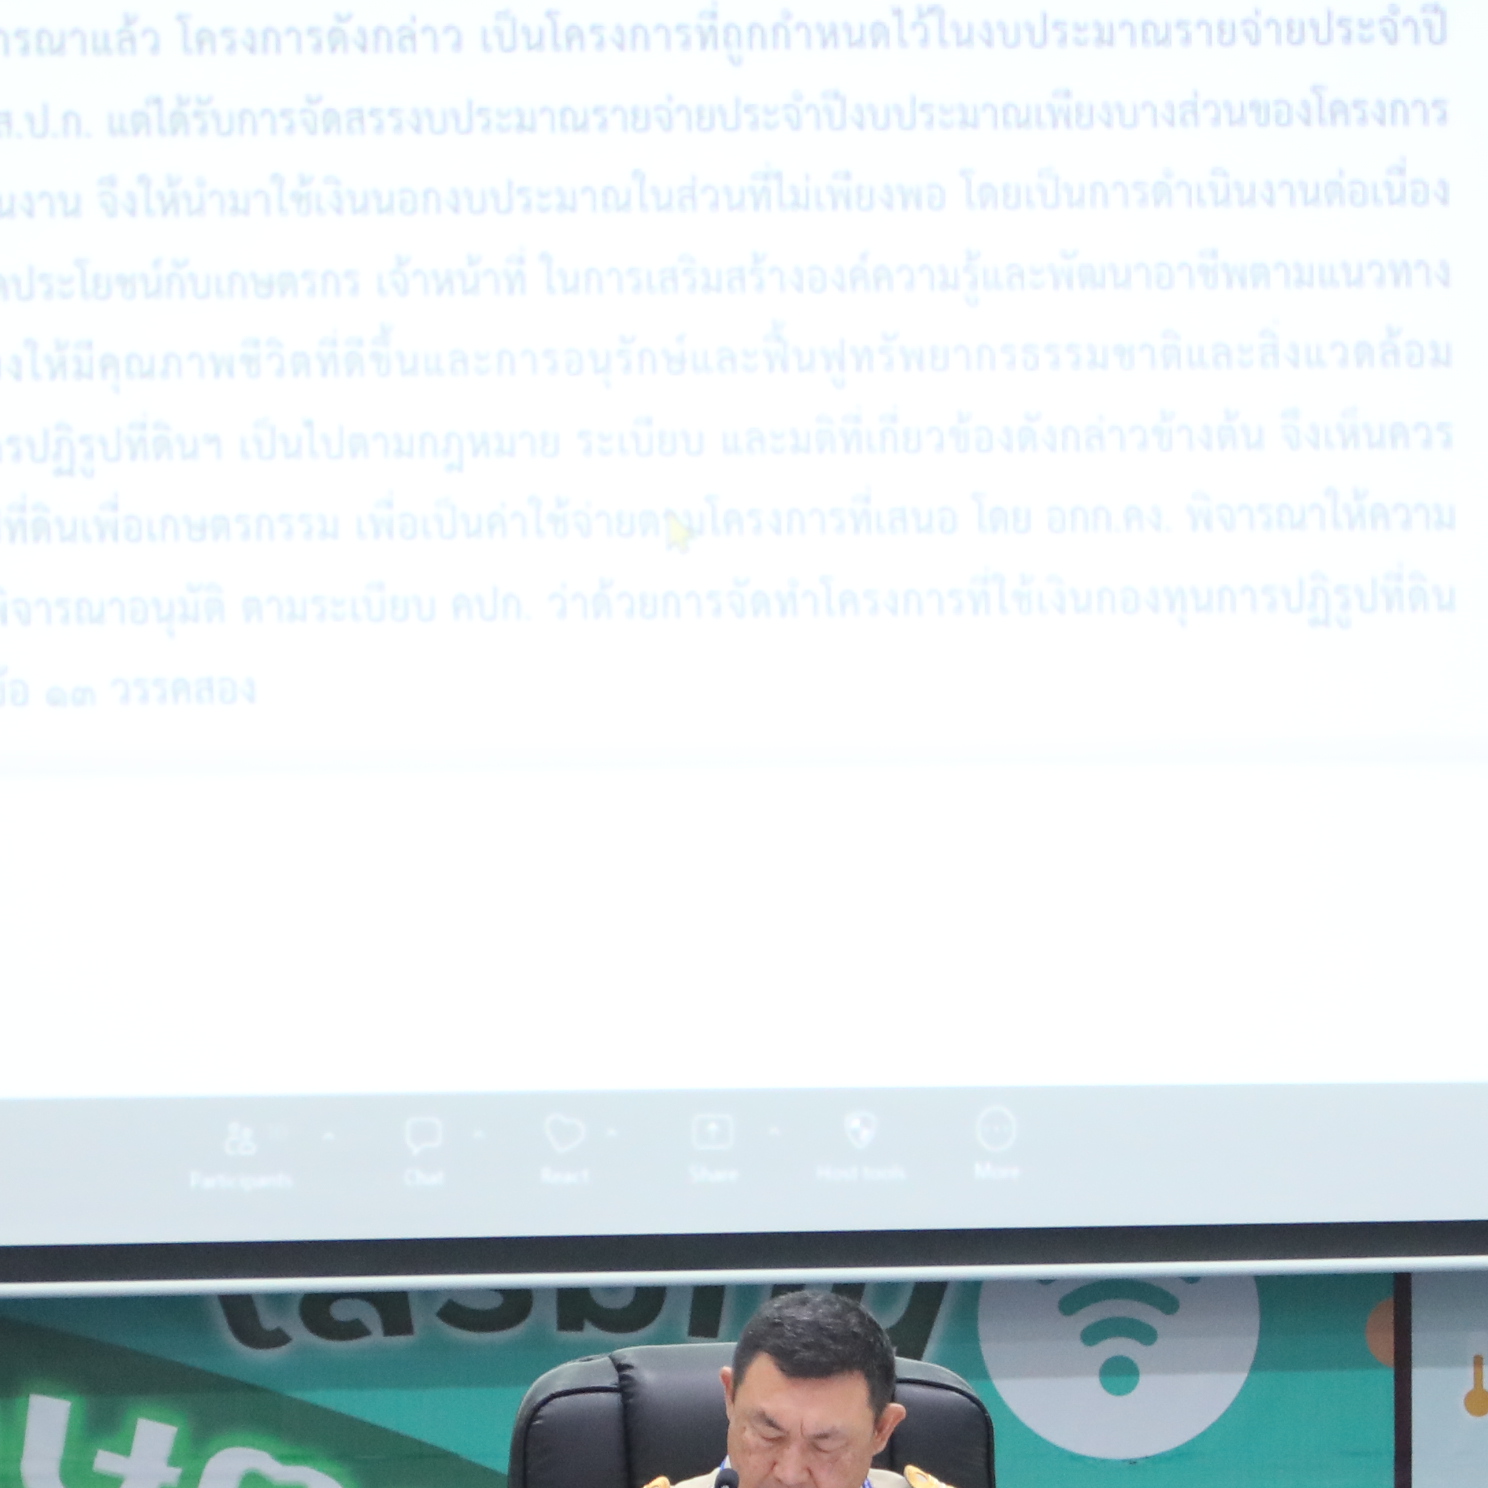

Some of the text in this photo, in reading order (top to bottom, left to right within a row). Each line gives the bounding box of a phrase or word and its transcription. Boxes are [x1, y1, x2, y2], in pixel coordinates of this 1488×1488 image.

[577, 414, 705, 457] ระเบียบ
[971, 491, 1032, 534] โดย
[451, 585, 532, 623] คปก.
[111, 674, 257, 705] วรรคสอง
